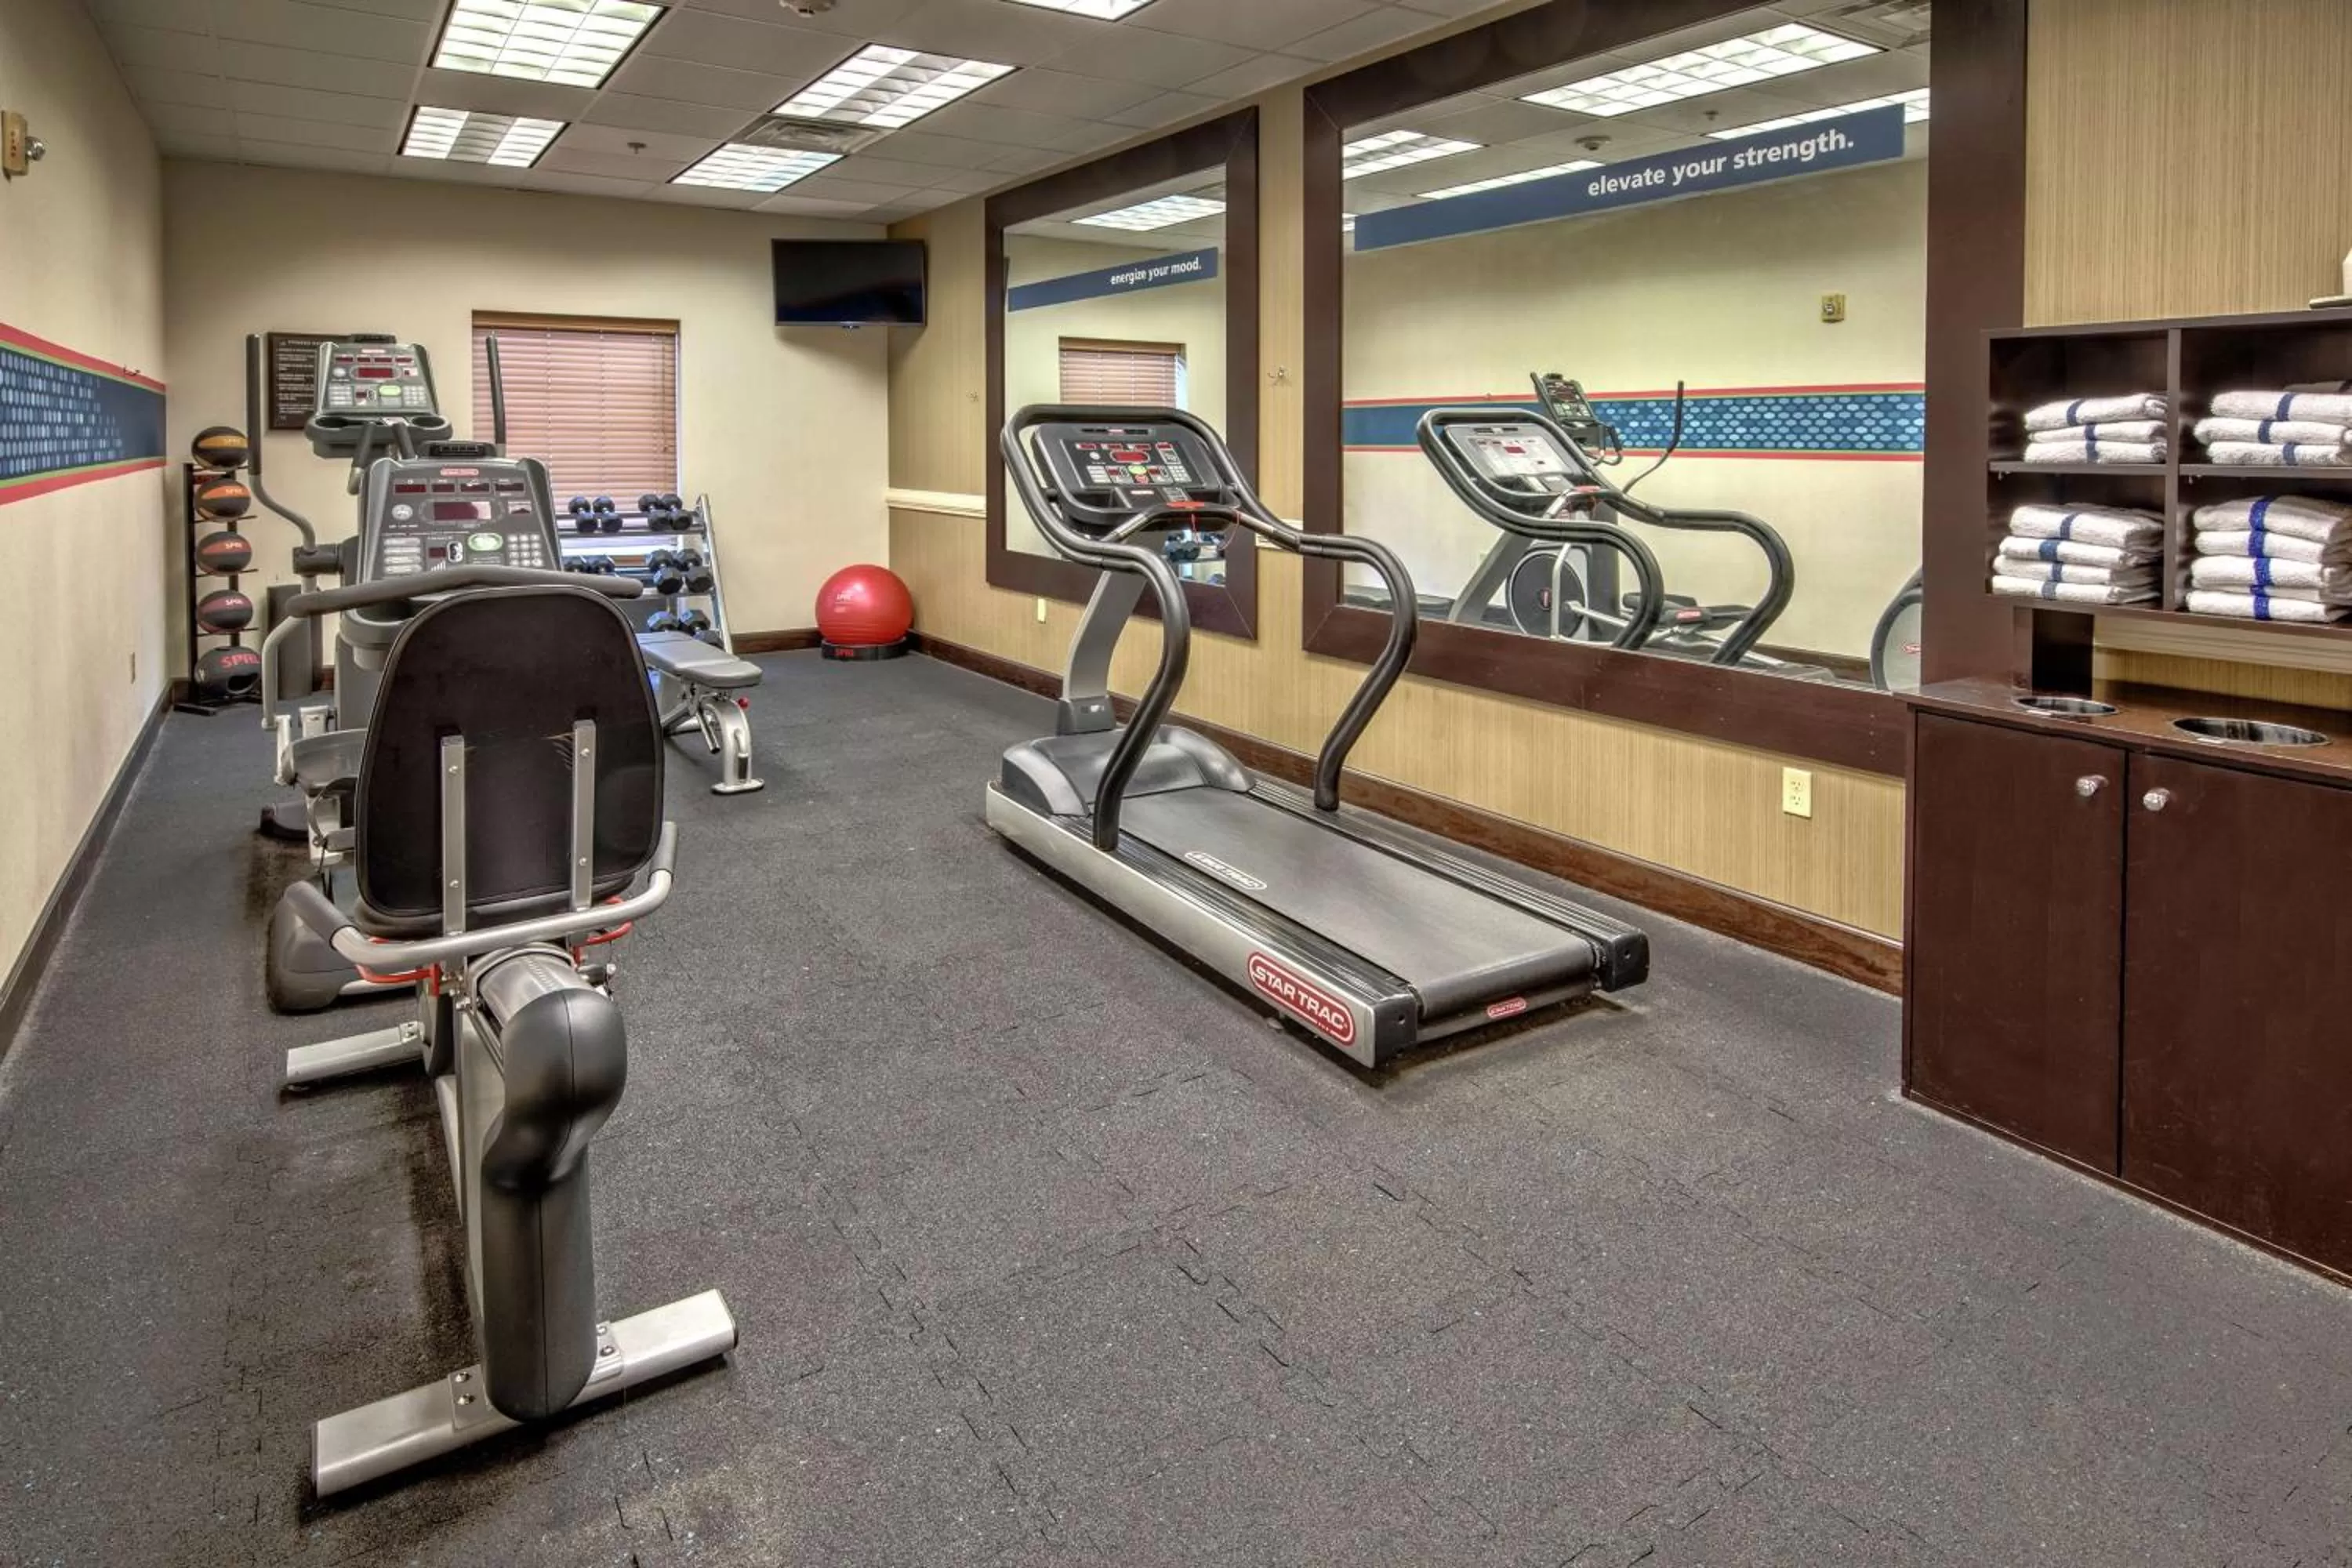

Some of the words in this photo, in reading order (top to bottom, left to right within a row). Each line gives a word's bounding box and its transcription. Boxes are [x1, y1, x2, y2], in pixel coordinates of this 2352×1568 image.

[1588, 167, 1665, 197] elevate
[1671, 154, 1726, 187] your
[1733, 129, 1855, 169] strength.
[1110, 267, 1146, 285] energize
[1148, 266, 1170, 281] your
[1171, 256, 1202, 274] mood.
[1253, 965, 1296, 1000] STAR
[1297, 990, 1345, 1030] TRAC
